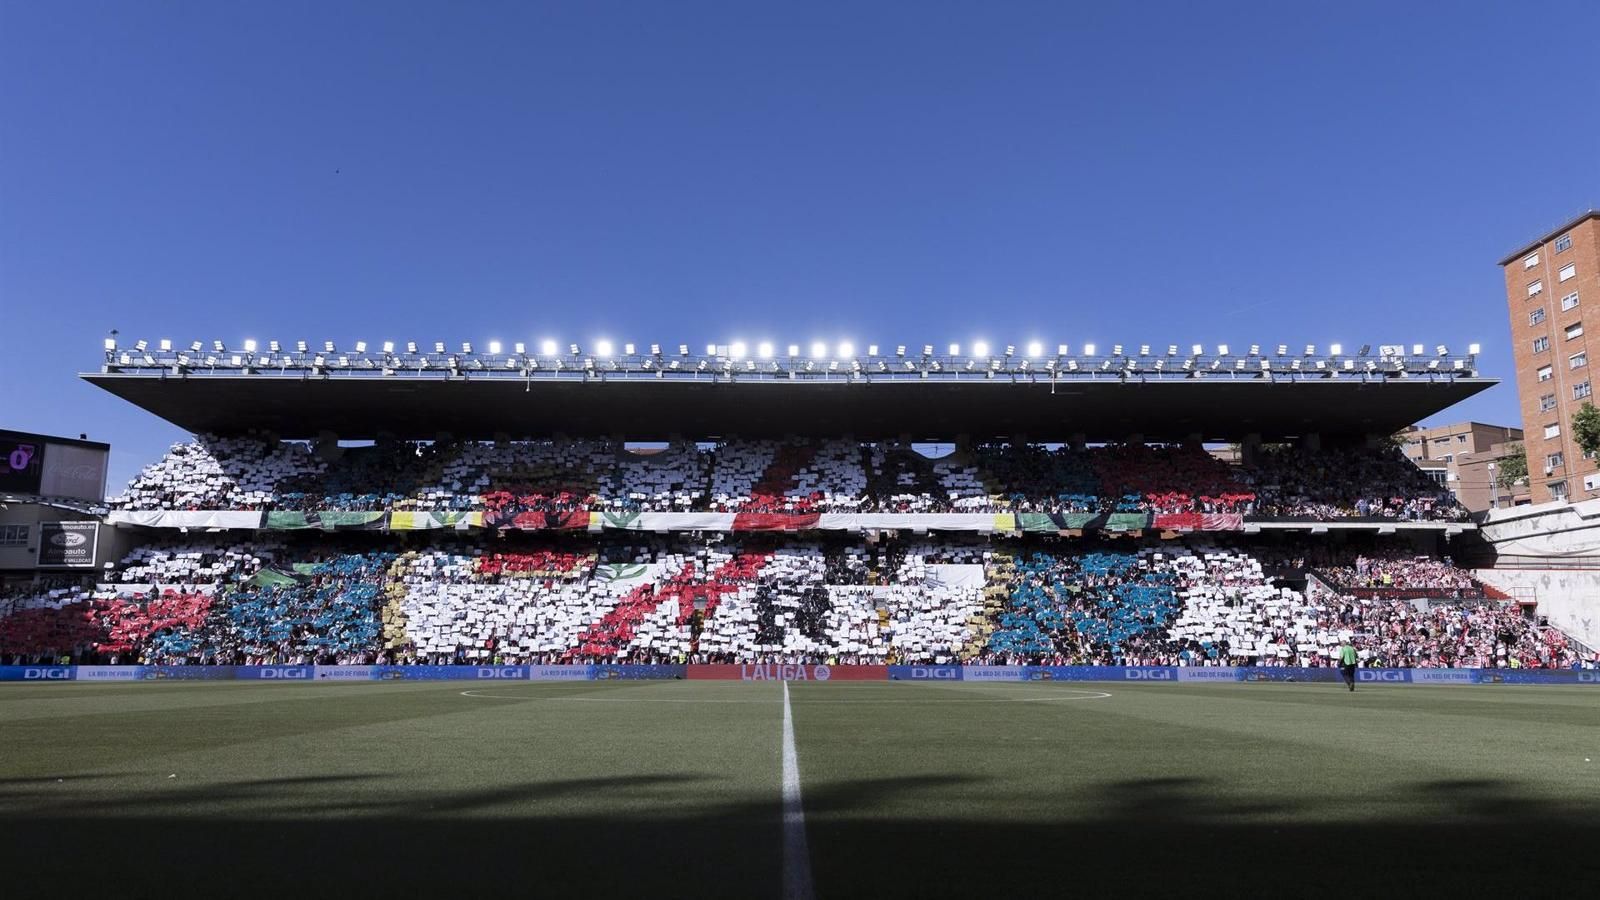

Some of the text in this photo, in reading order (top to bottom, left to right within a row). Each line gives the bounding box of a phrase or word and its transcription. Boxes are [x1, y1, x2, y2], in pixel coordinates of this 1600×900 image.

[55, 536, 80, 544] Ford
[24, 668, 69, 679] DIGI
[260, 668, 307, 679] DIGI
[477, 668, 523, 678] DIGI
[742, 664, 807, 680] LALIGA
[911, 668, 956, 678] DIGI
[1125, 669, 1170, 679] DIGI
[1359, 670, 1405, 681] DIGI
